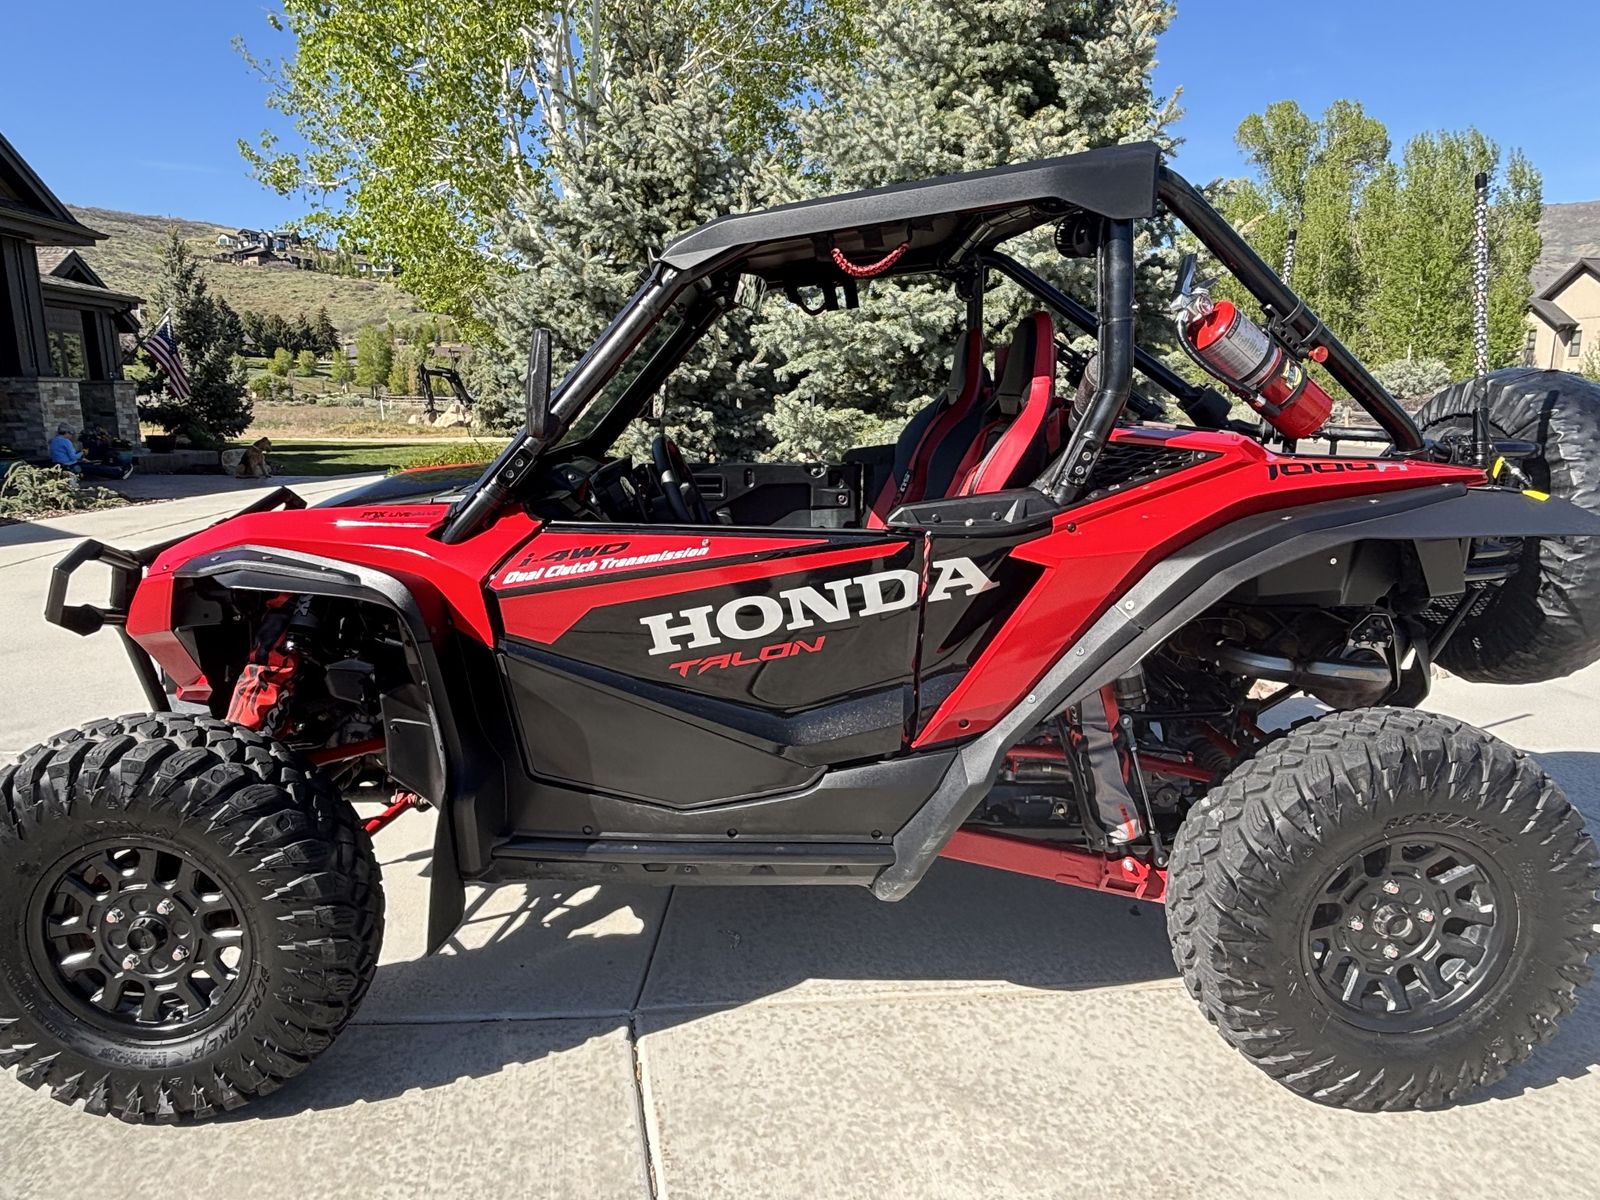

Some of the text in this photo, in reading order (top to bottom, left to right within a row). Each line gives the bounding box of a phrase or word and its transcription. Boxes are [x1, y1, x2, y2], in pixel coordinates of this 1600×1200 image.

[502, 547, 710, 585] Dual Clutch Transmission
[518, 541, 631, 567] i-4WD
[639, 556, 1000, 656] HONDA
[668, 635, 826, 678] TALON
